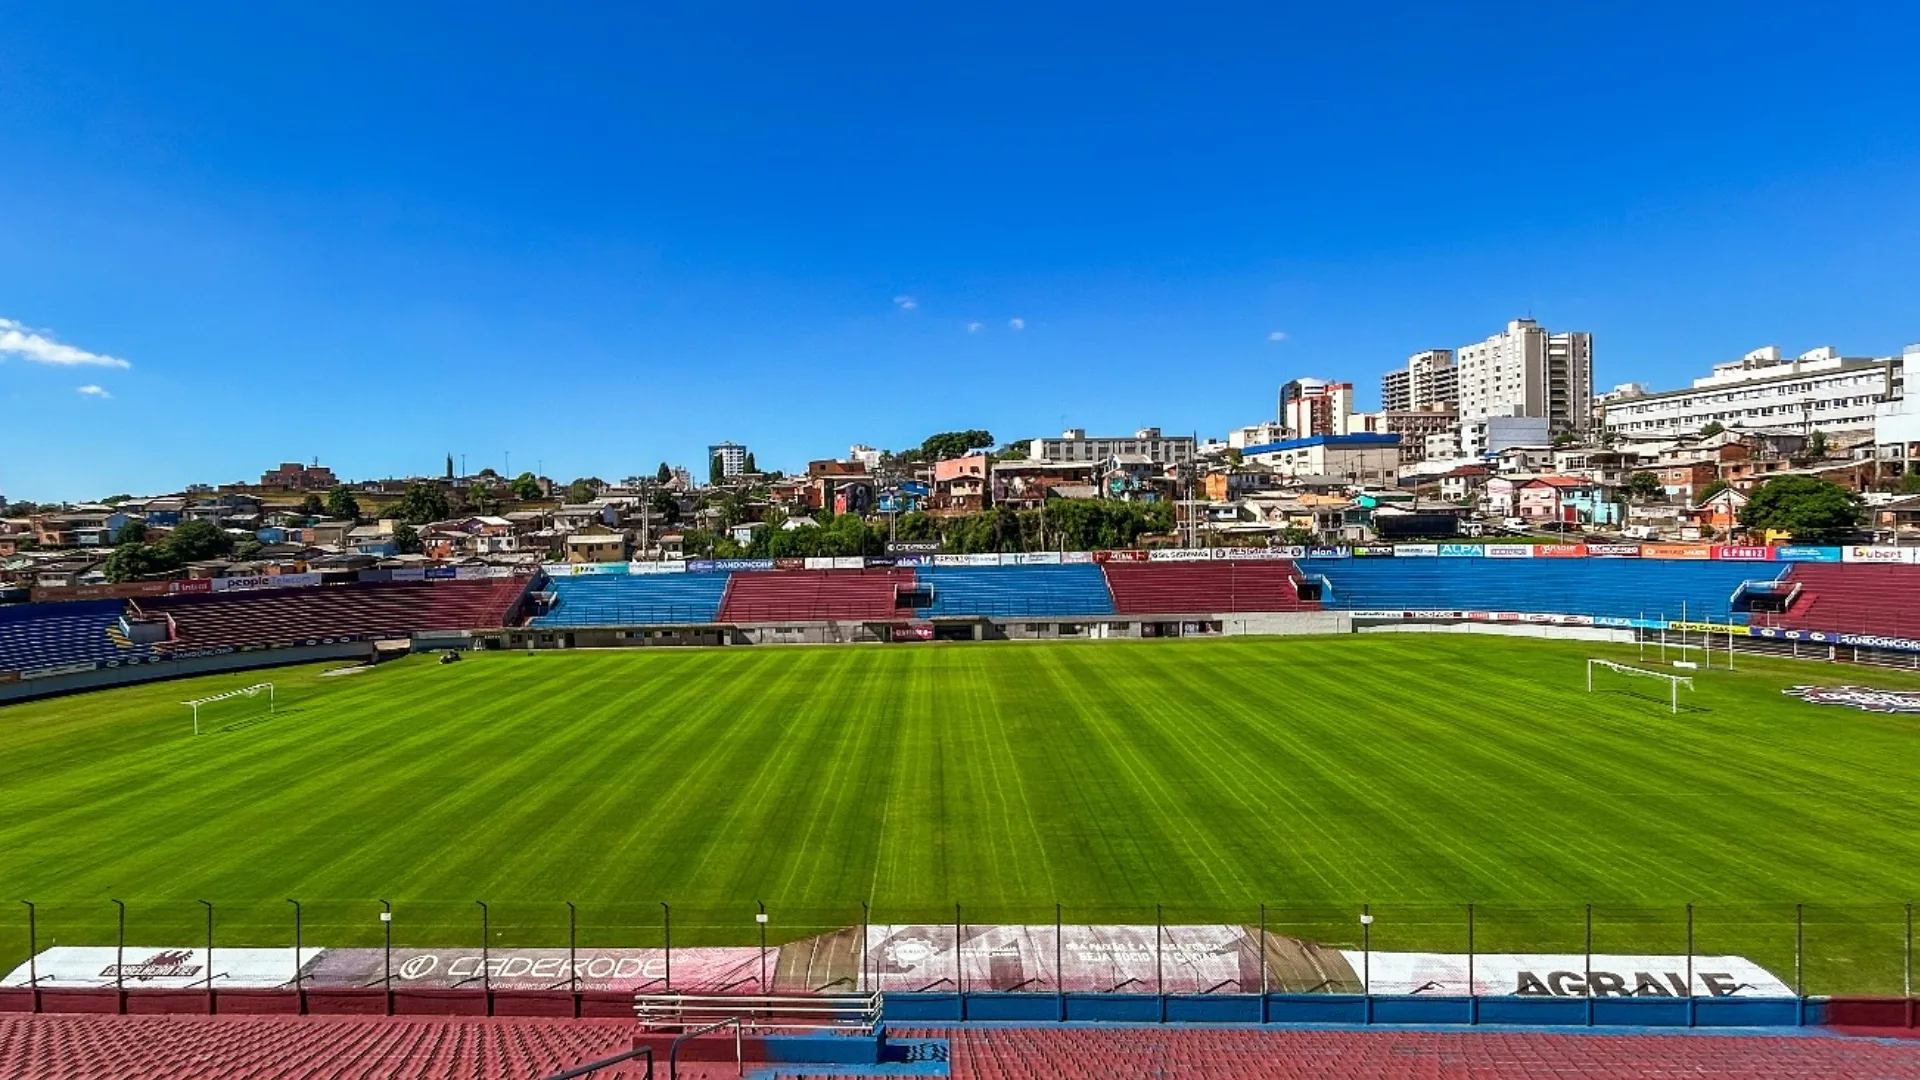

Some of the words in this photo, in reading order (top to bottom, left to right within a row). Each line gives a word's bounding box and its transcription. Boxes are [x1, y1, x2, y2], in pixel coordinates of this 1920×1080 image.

[227, 576, 269, 589] people
[1079, 952, 1112, 961] SEJA
[446, 957, 668, 978] CADERODE
